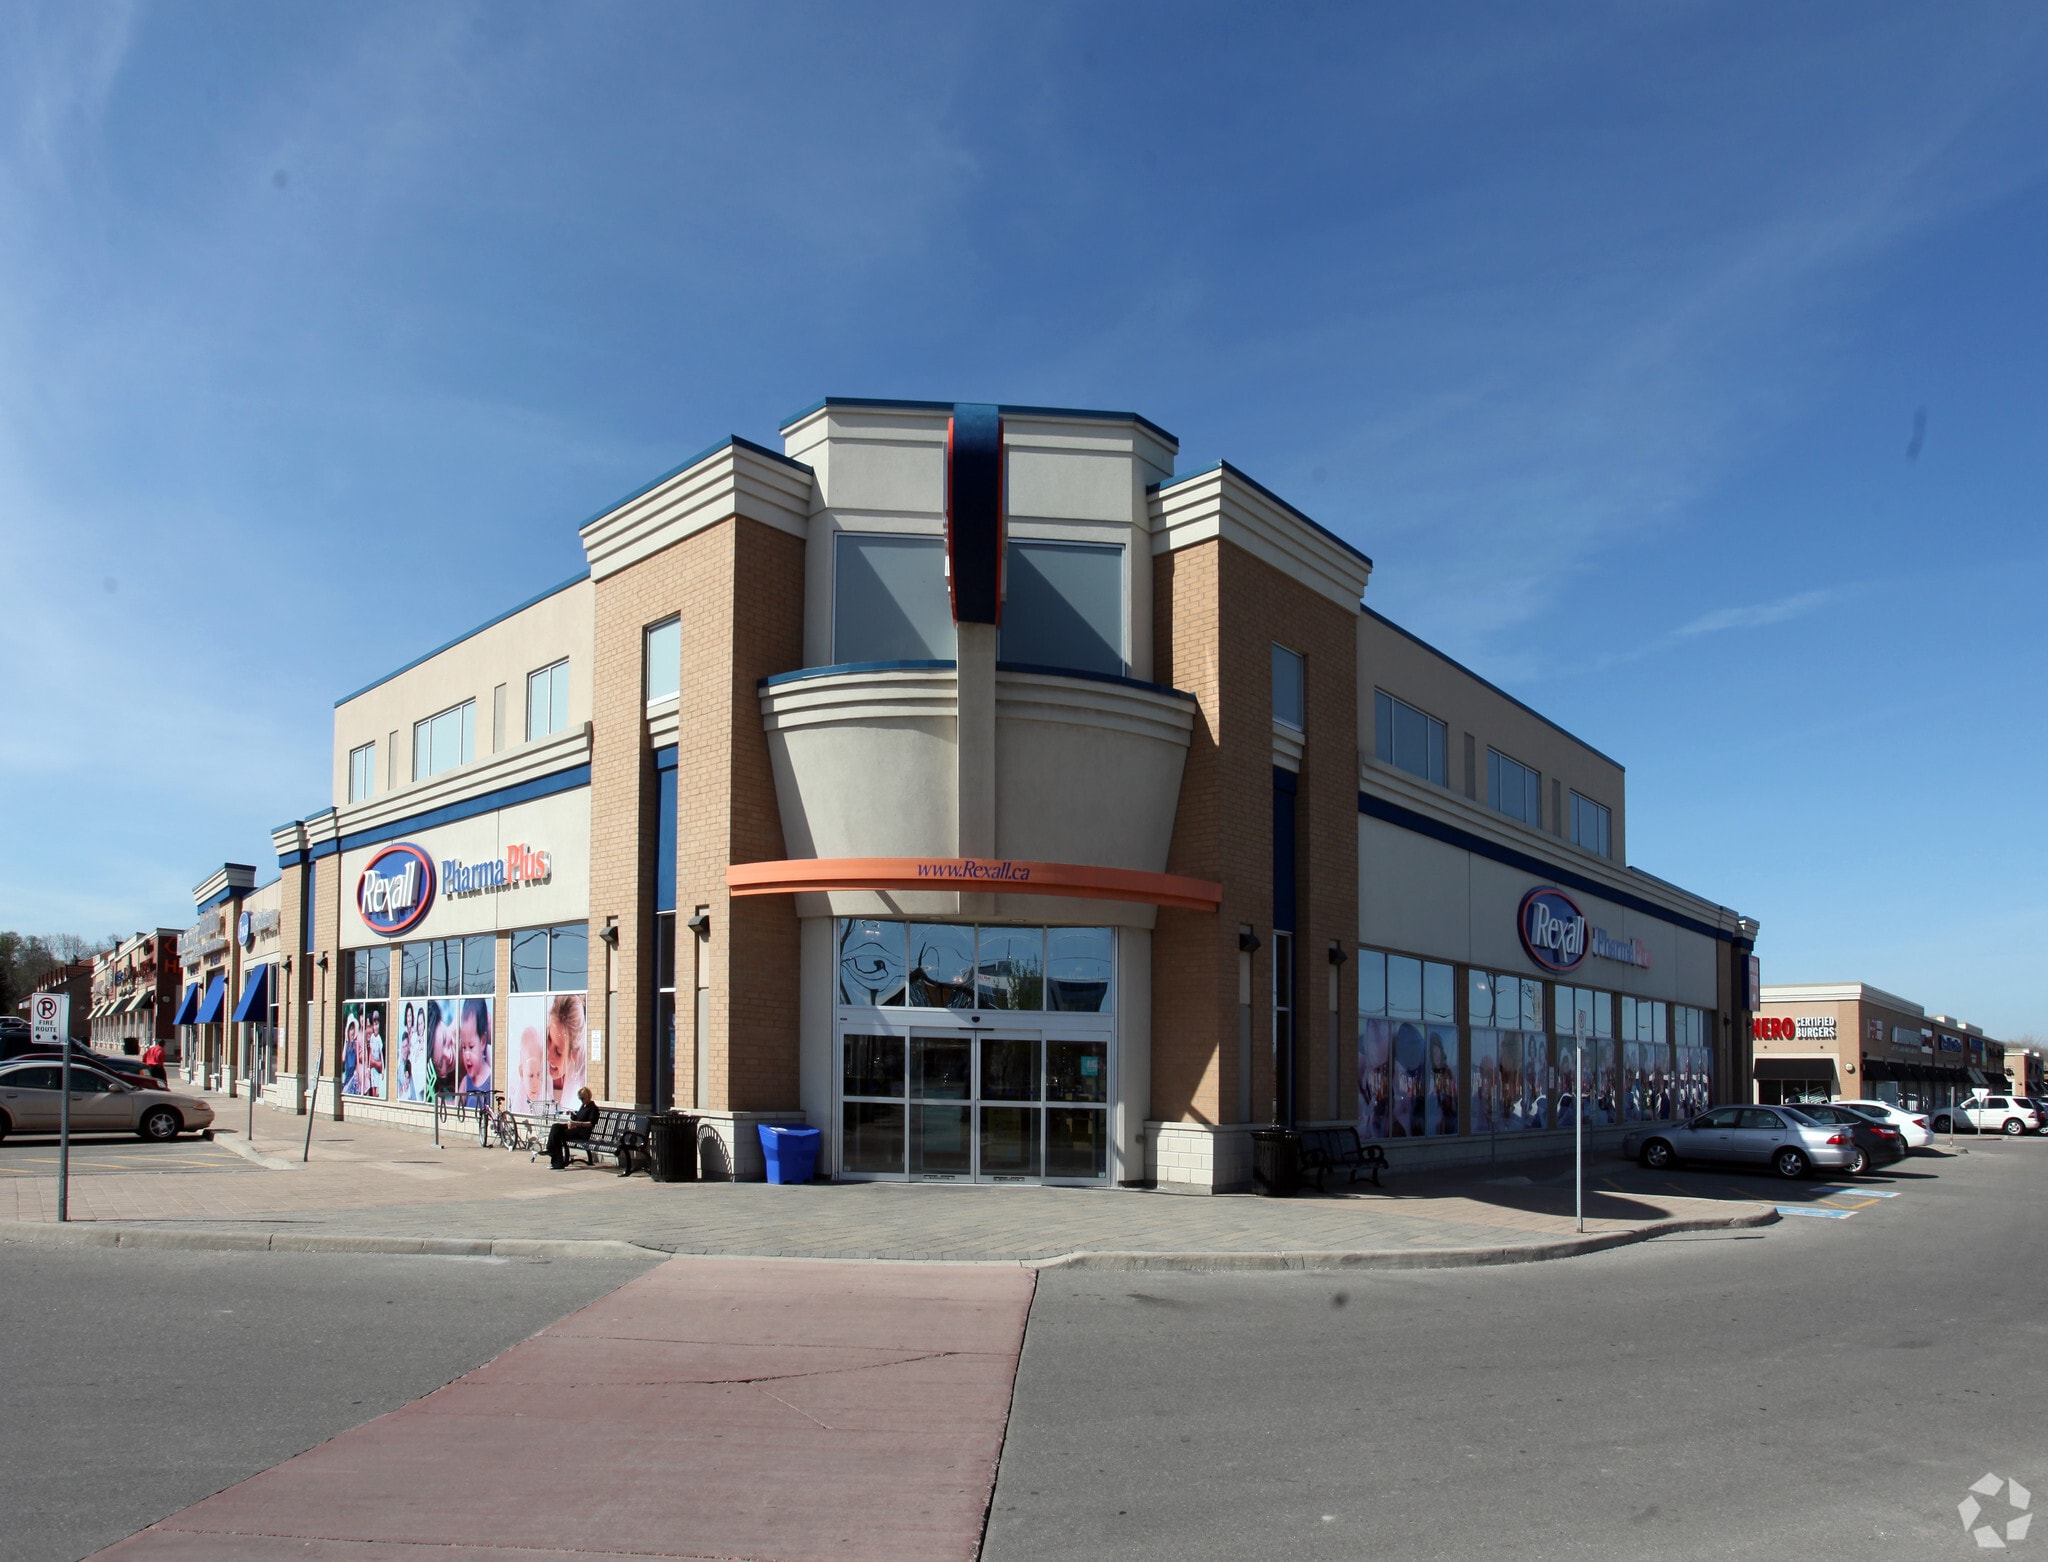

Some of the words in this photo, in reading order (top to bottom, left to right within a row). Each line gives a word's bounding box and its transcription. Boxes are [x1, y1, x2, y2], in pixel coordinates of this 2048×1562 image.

[917, 860, 1031, 880] www.Rexall.ca
[361, 860, 419, 922] Rexall
[1534, 902, 1585, 963] Rexall
[1752, 1017, 1796, 1040] HERO
[1795, 1016, 1836, 1027] CERTIFIED
[1795, 1027, 1836, 1038] BURGERS
